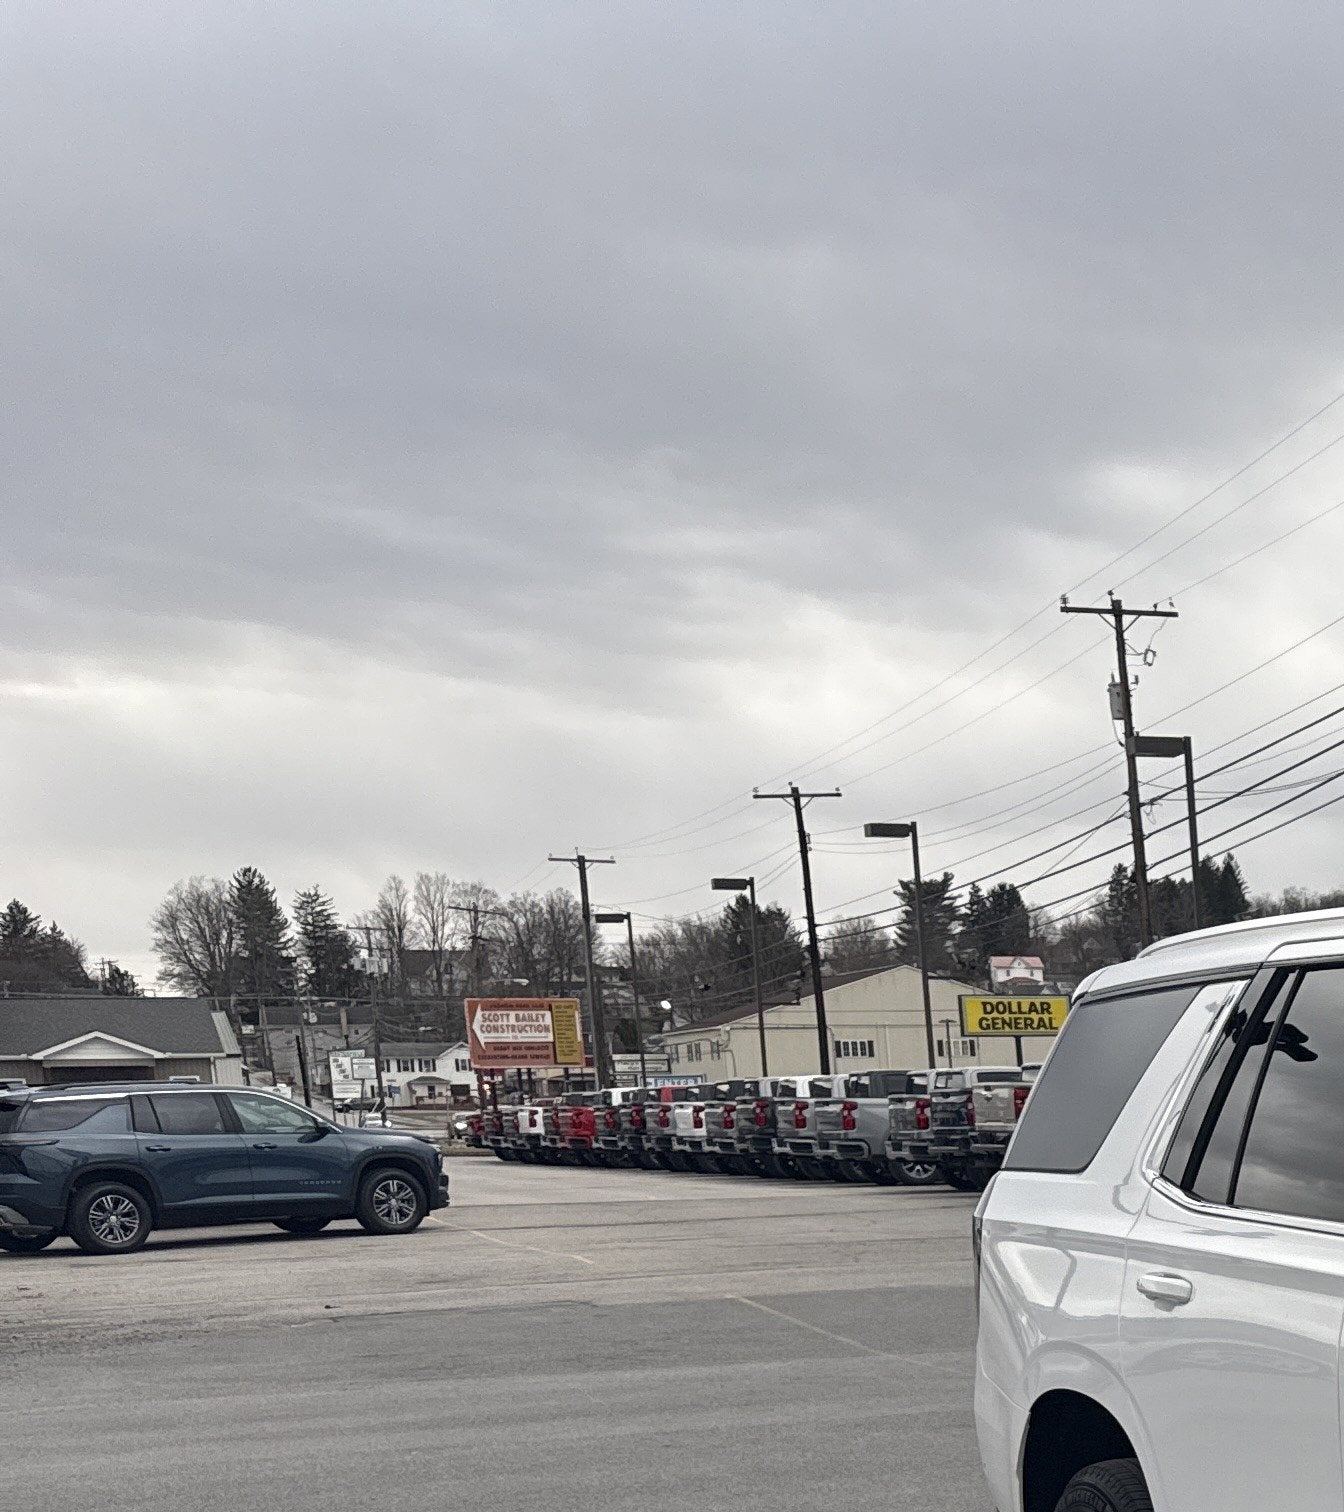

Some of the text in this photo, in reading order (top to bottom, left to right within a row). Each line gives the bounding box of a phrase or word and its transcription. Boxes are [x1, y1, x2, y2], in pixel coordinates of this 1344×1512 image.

[981, 1001, 1052, 1015] DOLLAR
[481, 1012, 546, 1023] SCOTT BAILEY
[480, 1024, 551, 1034] CONSTRUCTION
[978, 1017, 1058, 1031] GENERAL
